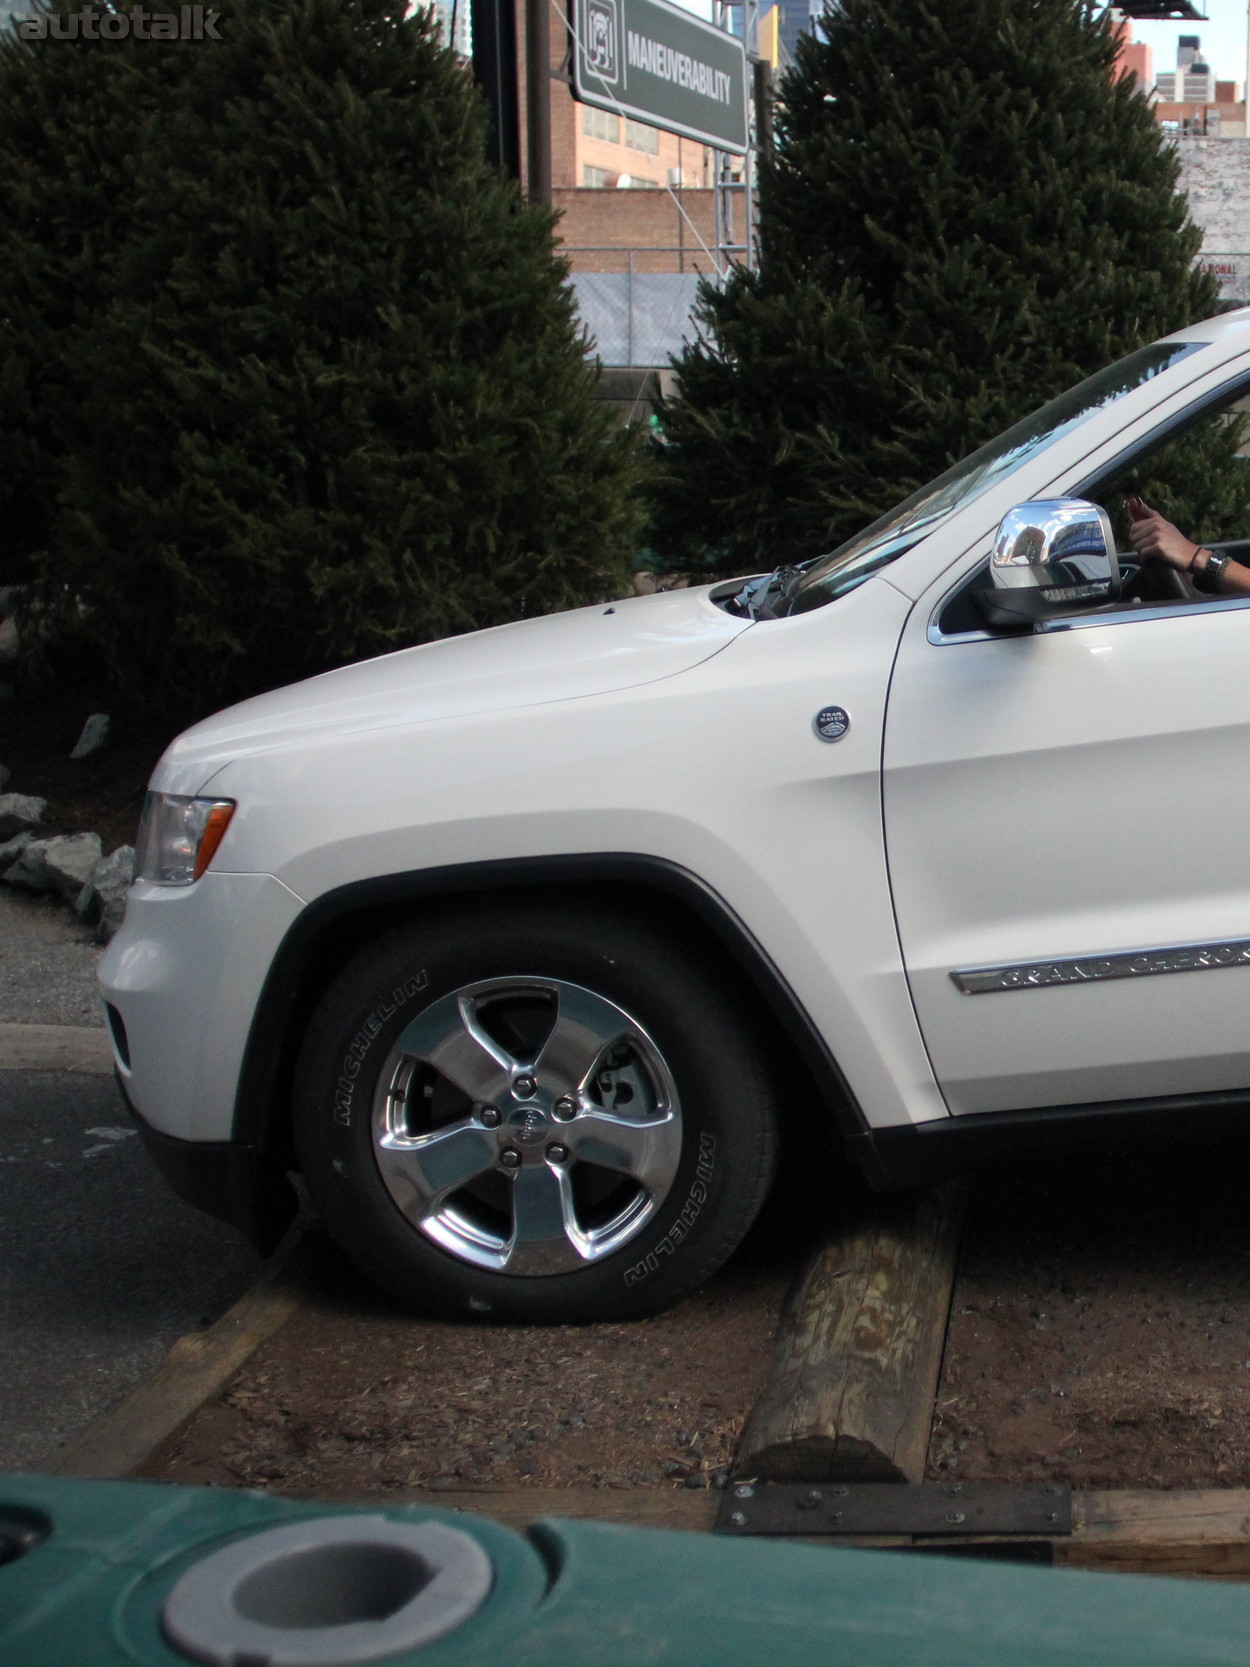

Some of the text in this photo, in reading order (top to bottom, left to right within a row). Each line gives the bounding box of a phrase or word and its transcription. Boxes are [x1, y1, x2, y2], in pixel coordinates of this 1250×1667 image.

[627, 30, 731, 105] MANEUVERABILITY
[1201, 264, 1237, 274] ATIONAL
[1000, 961, 1113, 987] GRAND
[333, 969, 429, 1126] MICHELIN
[623, 1132, 716, 1287] MICHELIN
